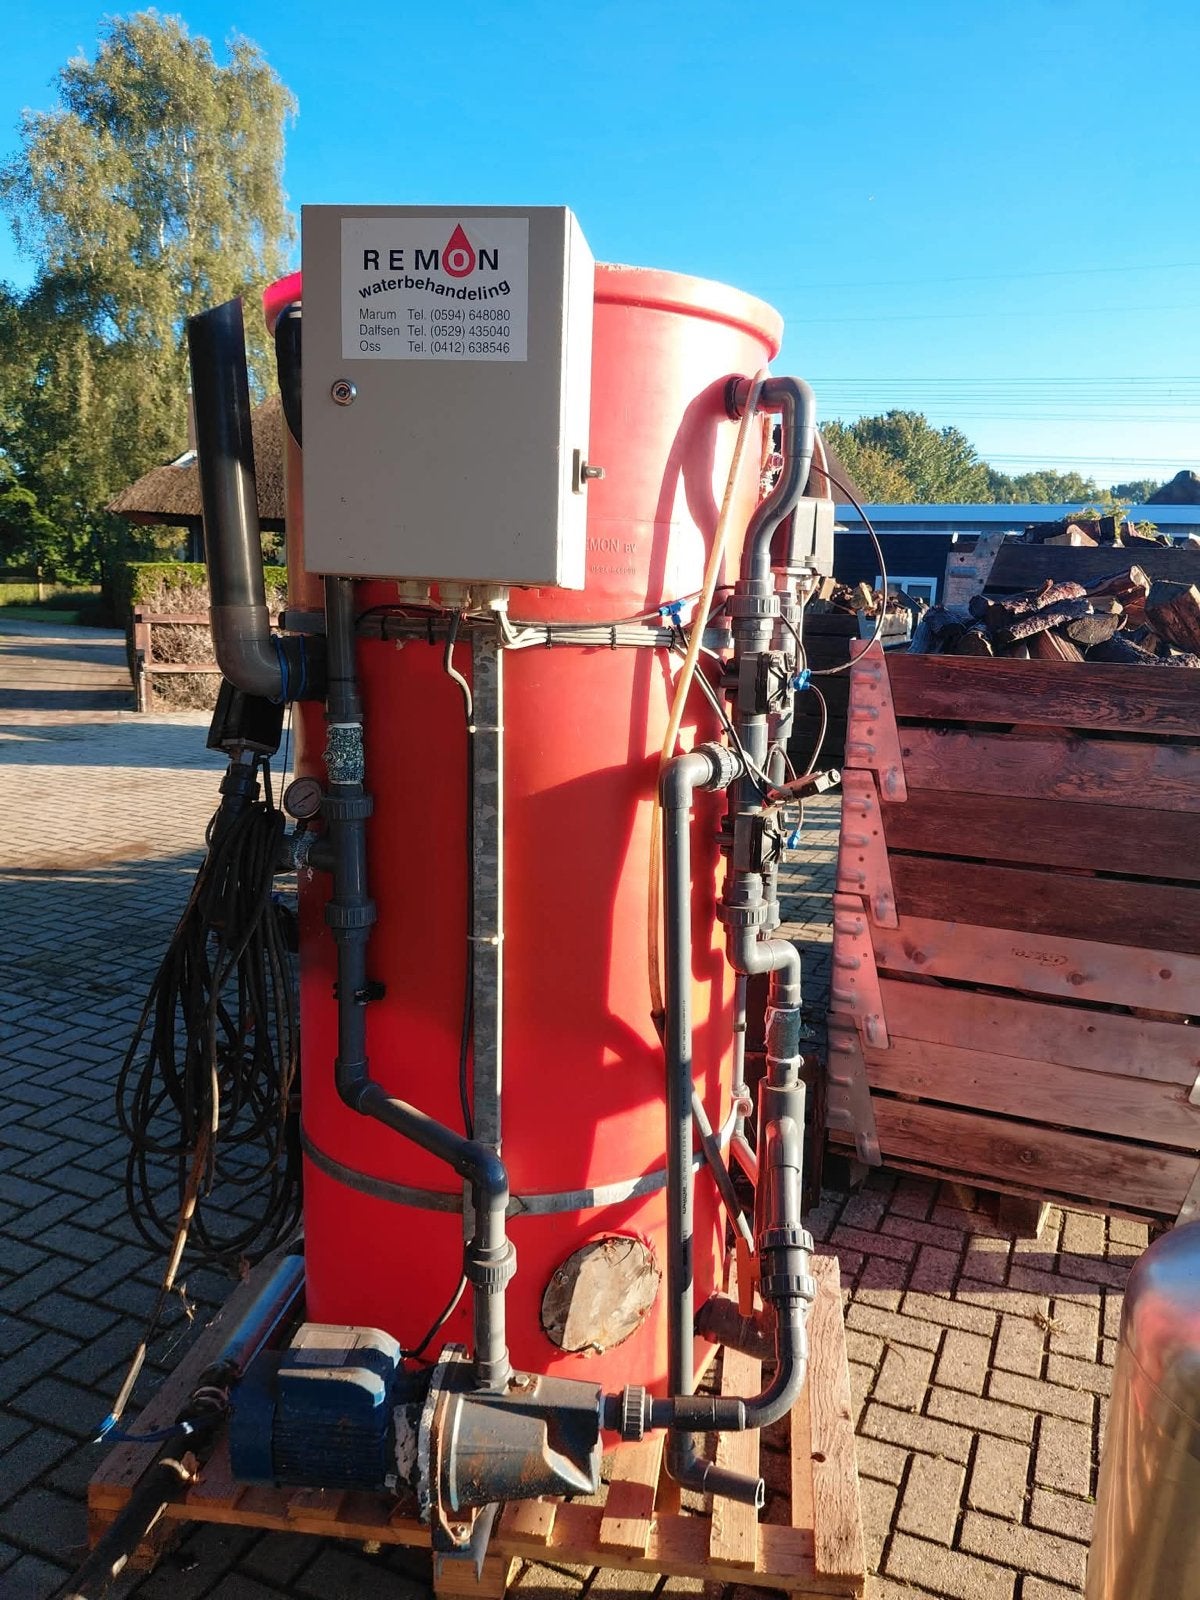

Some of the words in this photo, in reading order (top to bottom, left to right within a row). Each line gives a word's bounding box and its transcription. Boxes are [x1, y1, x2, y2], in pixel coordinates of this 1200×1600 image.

[363, 248, 499, 272] REMON
[358, 275, 511, 301] waterbehandeling
[359, 308, 397, 320] Marum
[407, 308, 426, 321] Tel.
[430, 309, 466, 323] (0594)
[468, 309, 511, 321] 648080
[359, 324, 400, 336] Dalfsen
[407, 324, 427, 337] Tel.
[430, 325, 466, 339] (0529)
[468, 325, 511, 337] 435040
[359, 340, 381, 352] Oss
[407, 340, 427, 353] Tel.
[430, 341, 466, 355] (0412)
[468, 341, 511, 354] 638546
[586, 537, 620, 553] MON
